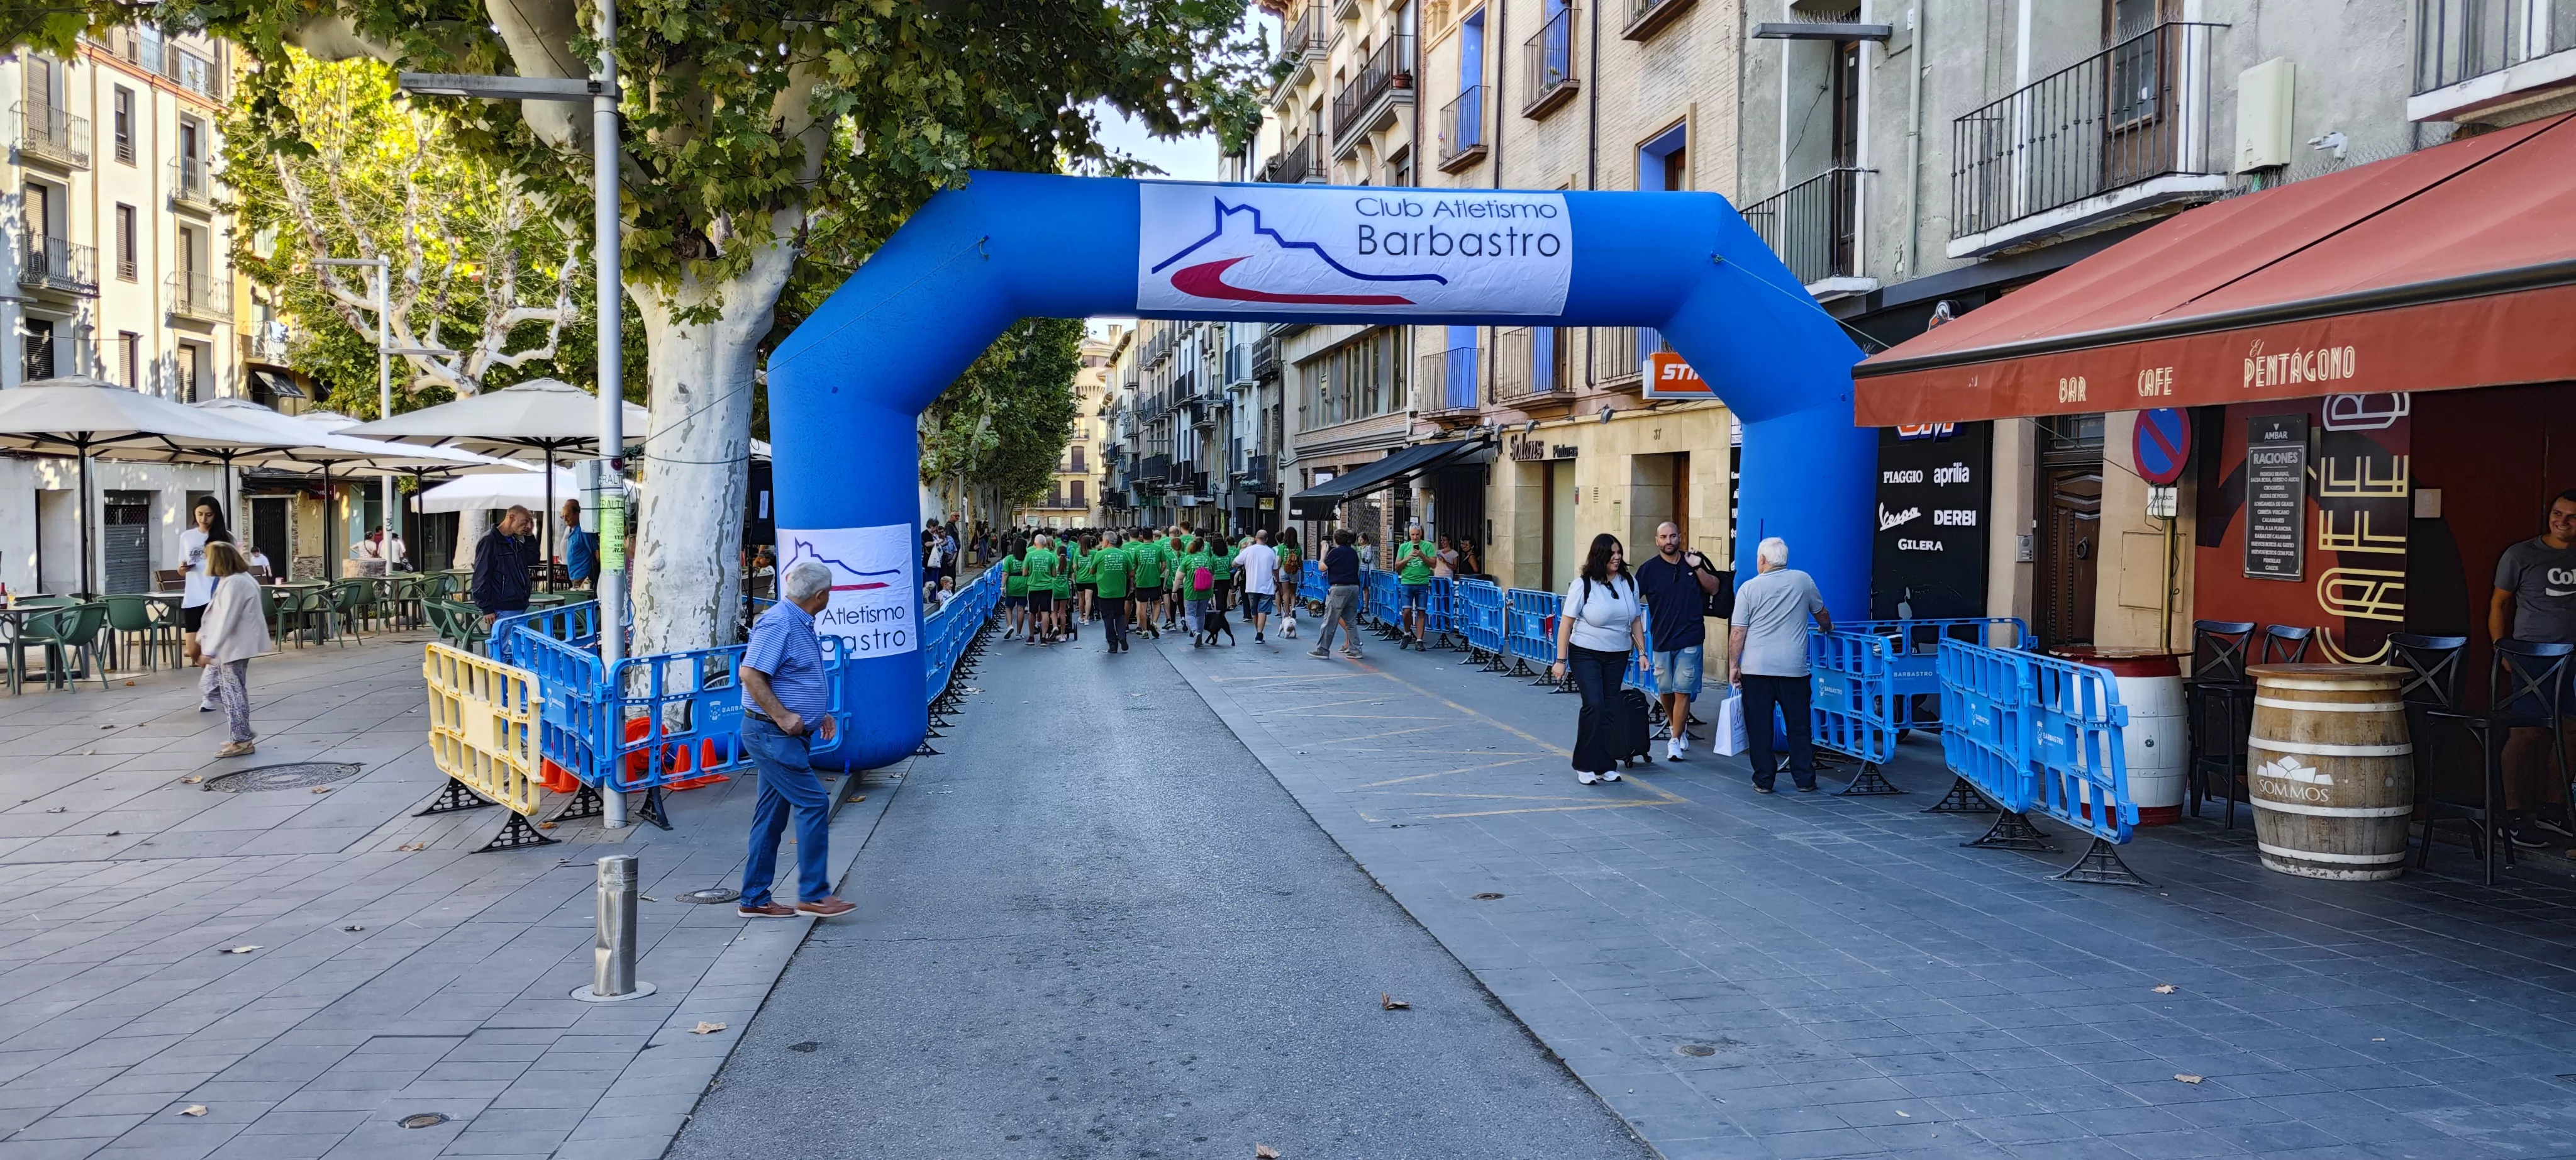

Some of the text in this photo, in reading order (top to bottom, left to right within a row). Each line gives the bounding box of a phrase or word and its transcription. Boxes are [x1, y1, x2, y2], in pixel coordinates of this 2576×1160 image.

[1355, 198, 1558, 219] Club Atletismo
[1358, 224, 1561, 257] Barbastro
[2250, 339, 2265, 358] El
[2058, 345, 2355, 403] BAR CAFE PENTÁGONO
[1653, 428, 1662, 440] 37
[2264, 431, 2289, 440] AMBAR
[1509, 432, 1545, 460] Solans
[2253, 452, 2299, 464] RACIONES
[1883, 462, 1970, 487] PIAGGIO aprilia
[1879, 501, 1976, 531] Vespa DERBI
[1897, 538, 1943, 551] GILERA
[821, 605, 904, 625] Atletismo
[721, 705, 744, 713] BARBA
[2259, 779, 2329, 802] SOMMOS
